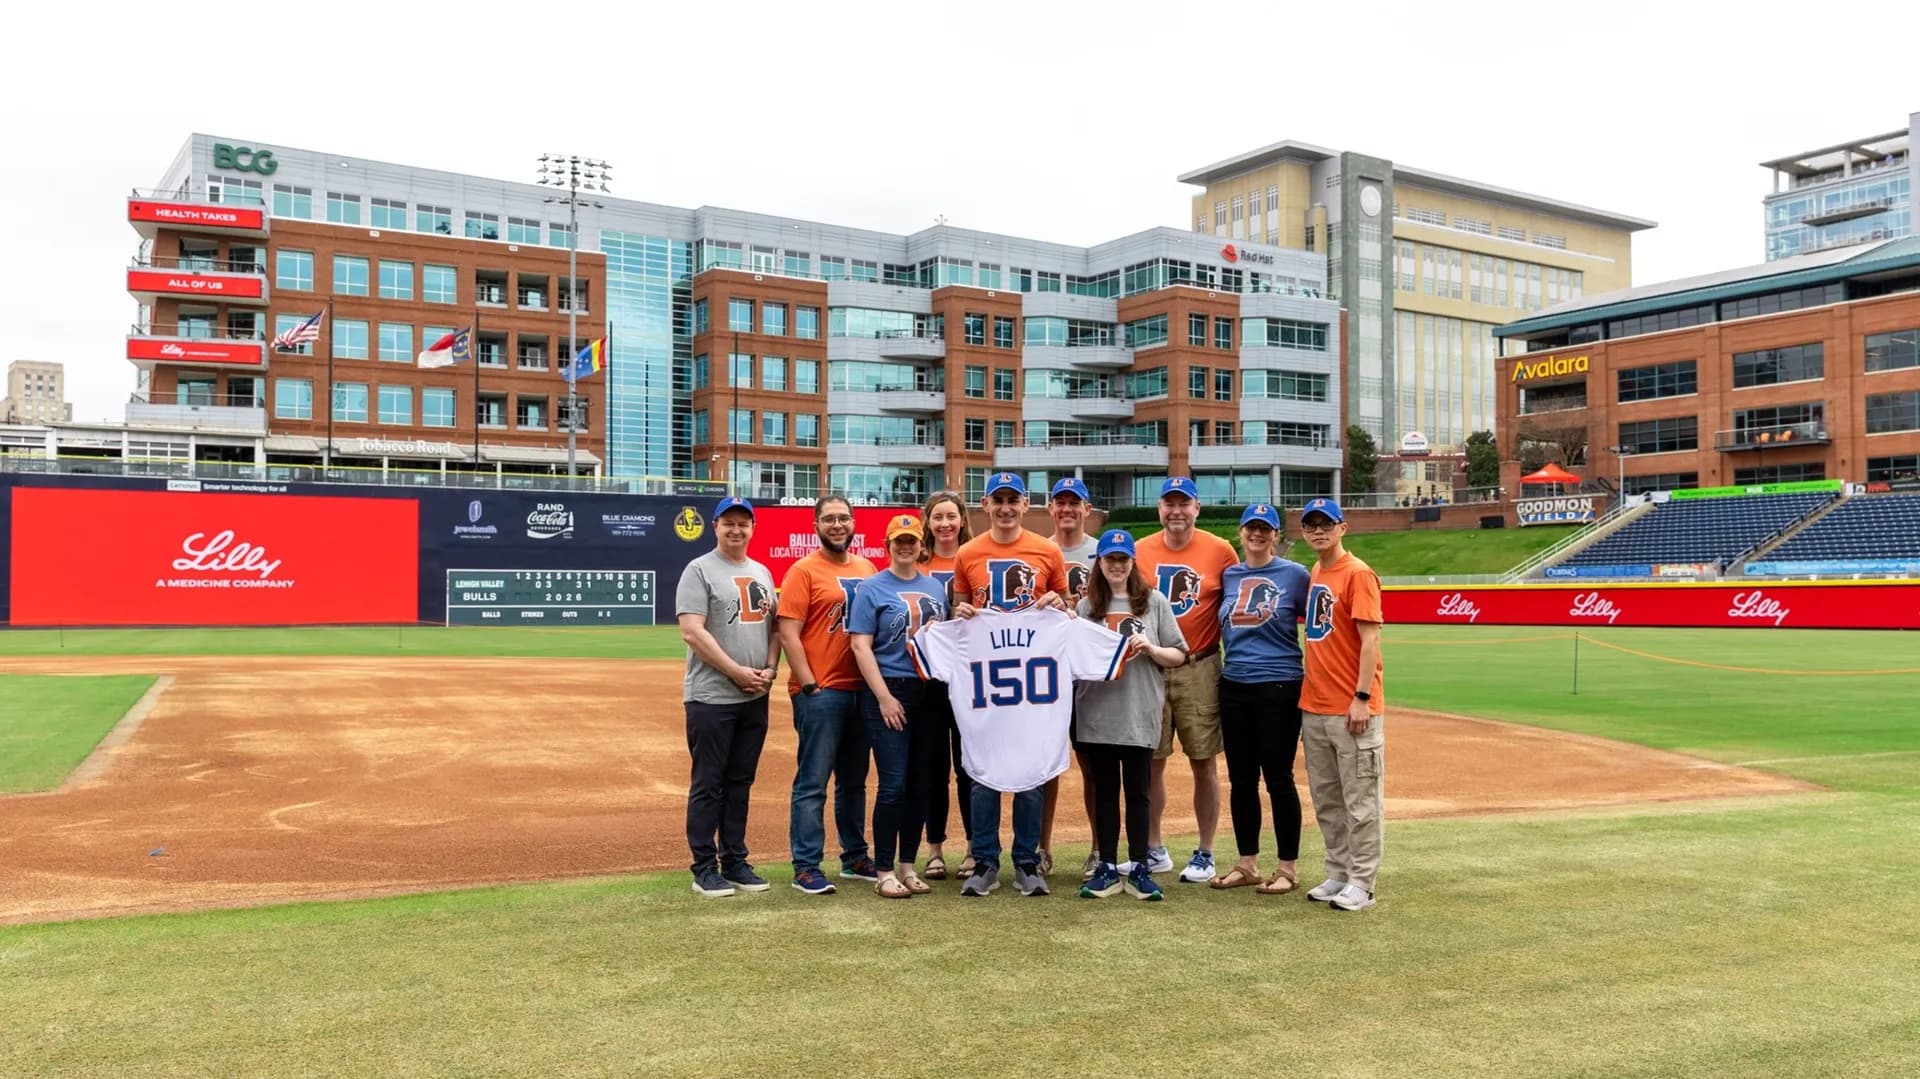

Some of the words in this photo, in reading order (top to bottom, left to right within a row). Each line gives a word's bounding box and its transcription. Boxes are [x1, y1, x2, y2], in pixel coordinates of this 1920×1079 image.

[215, 143, 278, 175] BCG
[155, 208, 200, 219] HEALTH
[202, 211, 237, 222] TAKES
[1240, 250, 1257, 262] Red
[1259, 253, 1274, 264] Hat
[168, 279, 189, 288] ALL
[191, 280, 206, 288] OF
[208, 281, 223, 289] US
[1511, 355, 1589, 382] Avalara
[357, 437, 413, 453] Tobacco
[416, 440, 451, 454] Road
[203, 483, 230, 491] Smarter
[232, 483, 268, 493] technology
[269, 484, 278, 492] for
[537, 503, 564, 511] RAND
[780, 497, 819, 506] GOOD
[1516, 498, 1593, 513] GOODMON
[1528, 511, 1576, 522] FIELD
[172, 530, 282, 578] Lilly
[769, 547, 805, 558] LOCATED
[156, 579, 165, 588] A
[168, 579, 231, 588] MEDICINE
[233, 579, 295, 588] COMPANY
[455, 580, 480, 589] LEHIGH
[480, 580, 504, 589] VALLEY
[535, 580, 541, 589] 0
[546, 580, 552, 589] 3
[576, 580, 582, 589] 3
[586, 580, 592, 589] 1
[617, 580, 624, 589] 0
[631, 580, 637, 589] 0
[642, 580, 649, 589] 0
[463, 592, 497, 601] BULLS
[545, 592, 552, 601] 2
[555, 592, 562, 601] 0
[566, 592, 572, 601] 2
[617, 592, 624, 601] 0
[630, 592, 637, 601] 0
[642, 592, 649, 601] 0
[1436, 592, 1481, 623] Lilly
[1569, 591, 1624, 624] Lilly
[1728, 590, 1790, 626] Lilly
[990, 628, 1036, 650] LILLY
[970, 656, 1059, 709] 150
